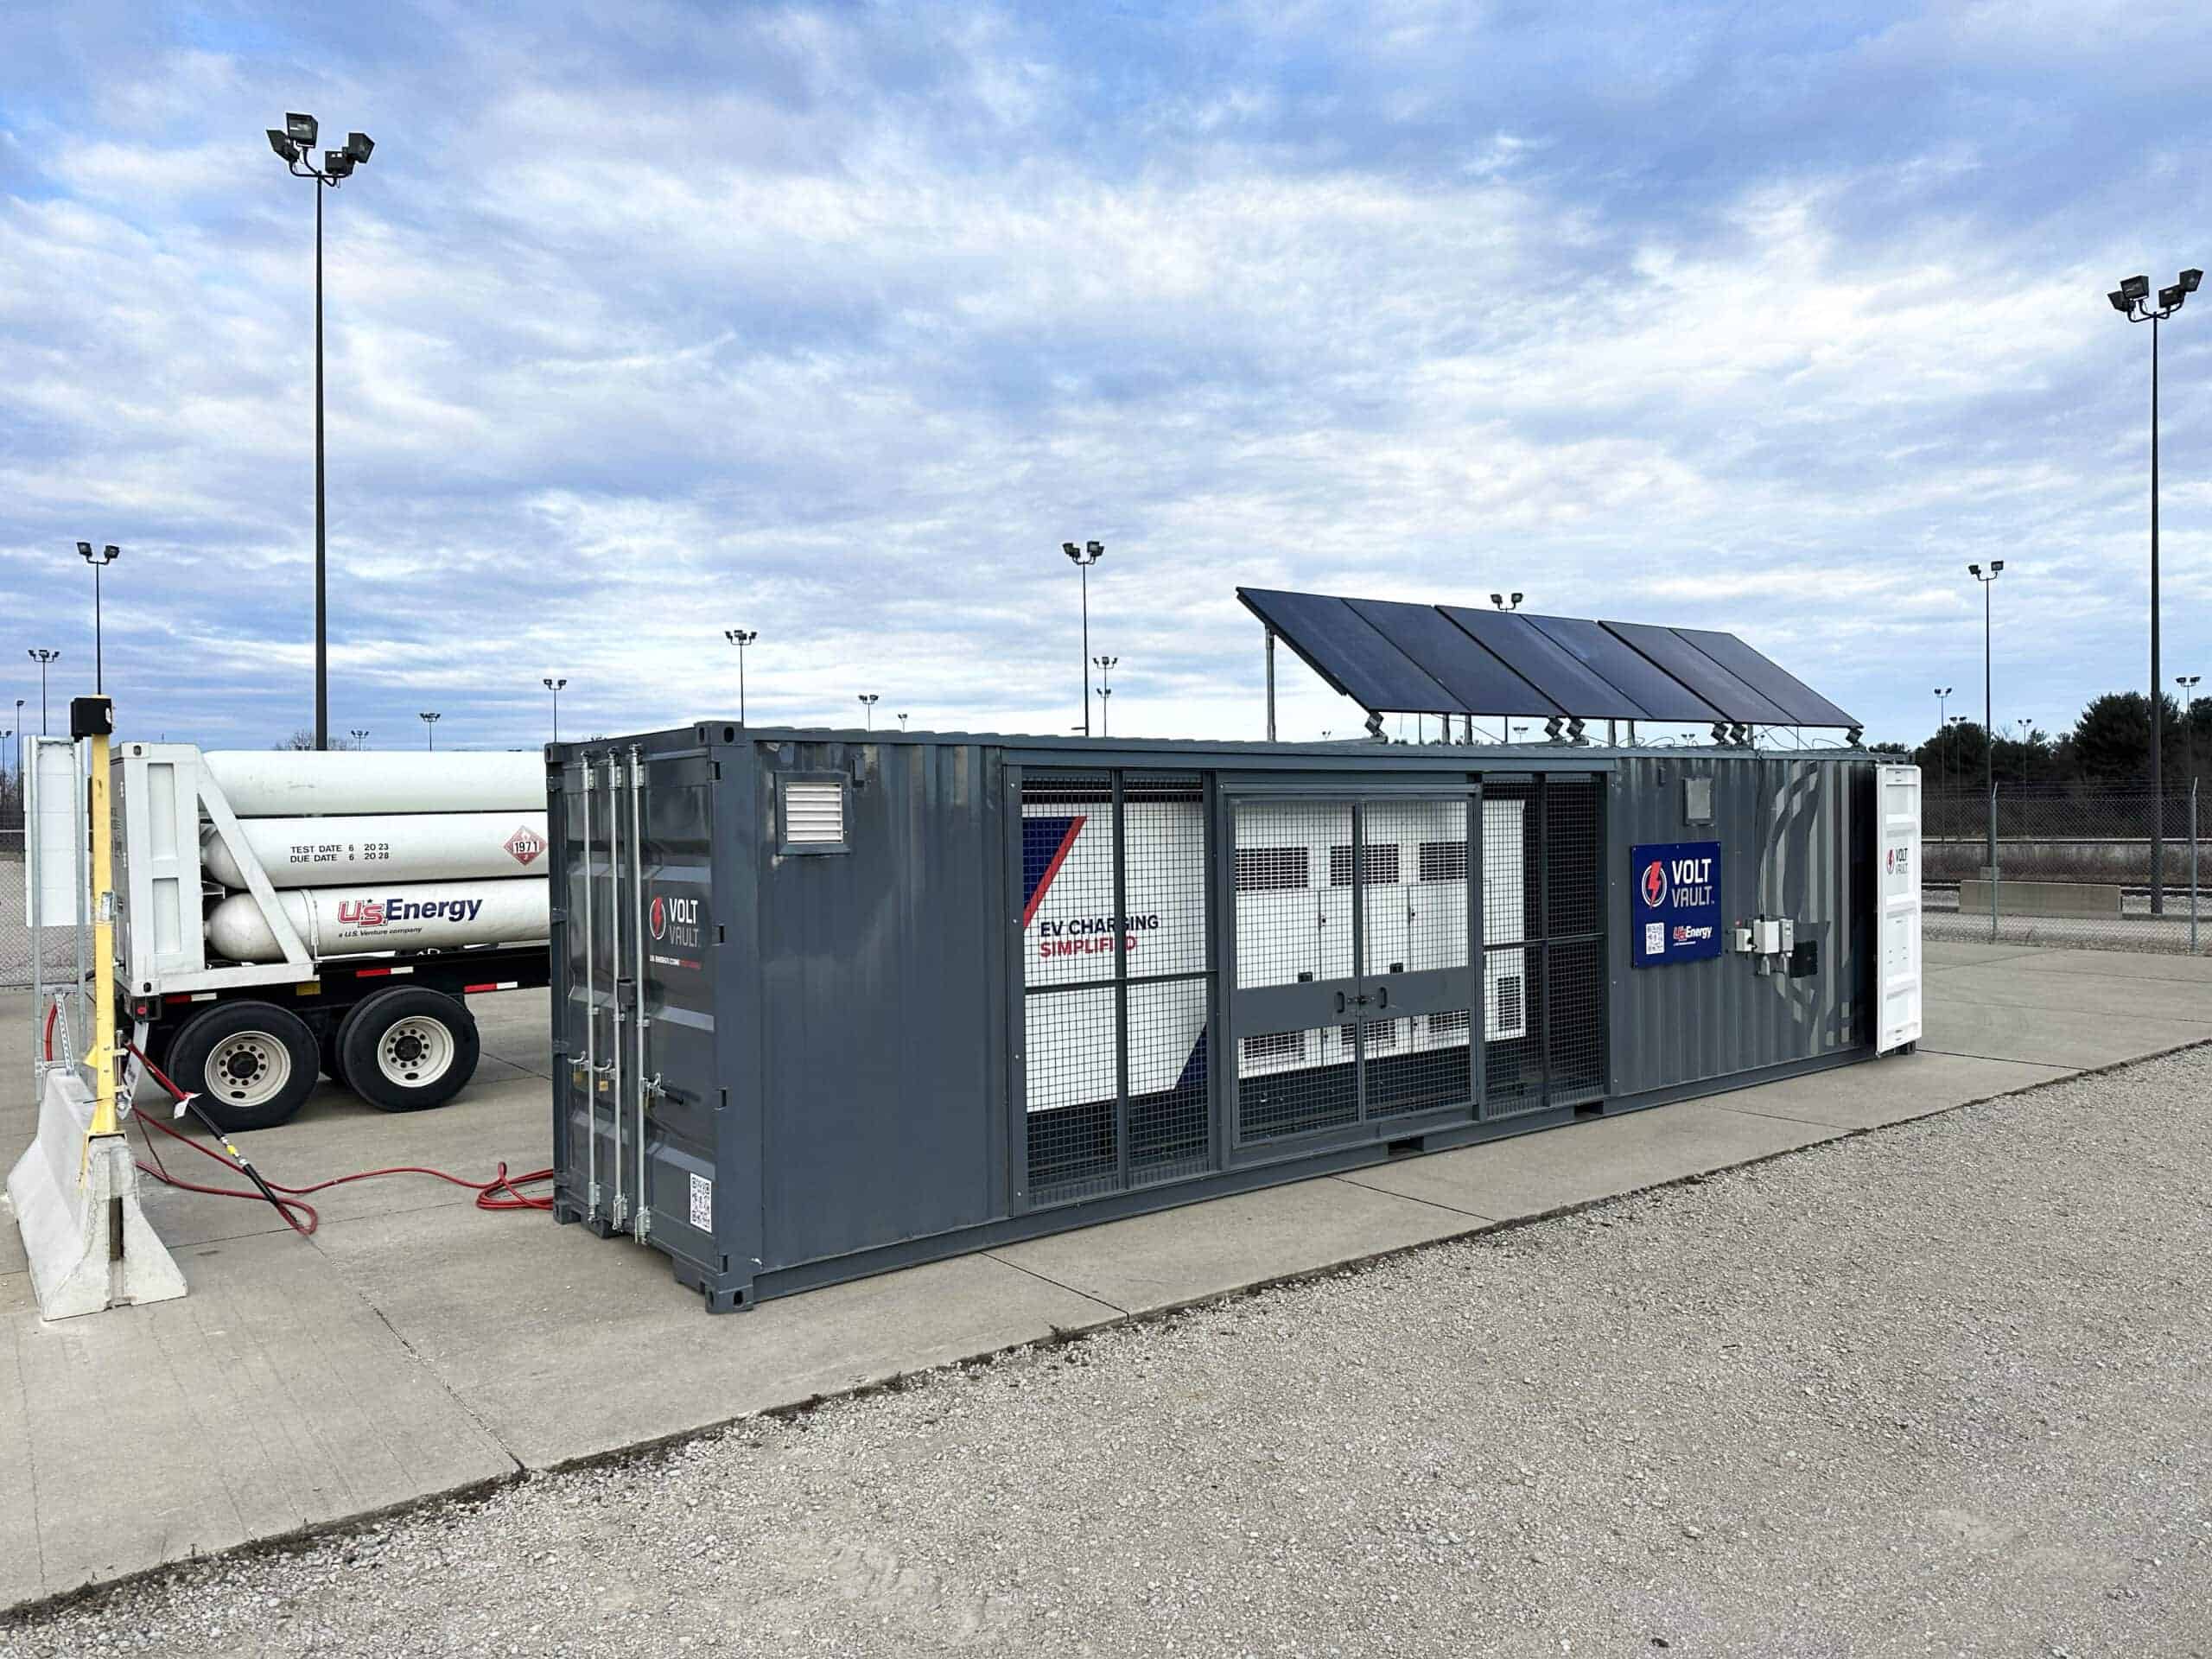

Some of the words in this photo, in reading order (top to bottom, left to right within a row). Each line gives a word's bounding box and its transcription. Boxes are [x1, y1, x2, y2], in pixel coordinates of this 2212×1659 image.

[319, 844, 342, 853] DATE
[515, 842, 537, 853] 1971
[290, 855, 310, 863] DUE
[1672, 858, 1712, 885] VOLT
[1672, 886, 1713, 908] VAULT
[669, 898, 698, 925] VOLT
[669, 925, 699, 947] VAULT
[1040, 921, 1064, 938] EV
[1040, 936, 1137, 957] SIMPLIFID
